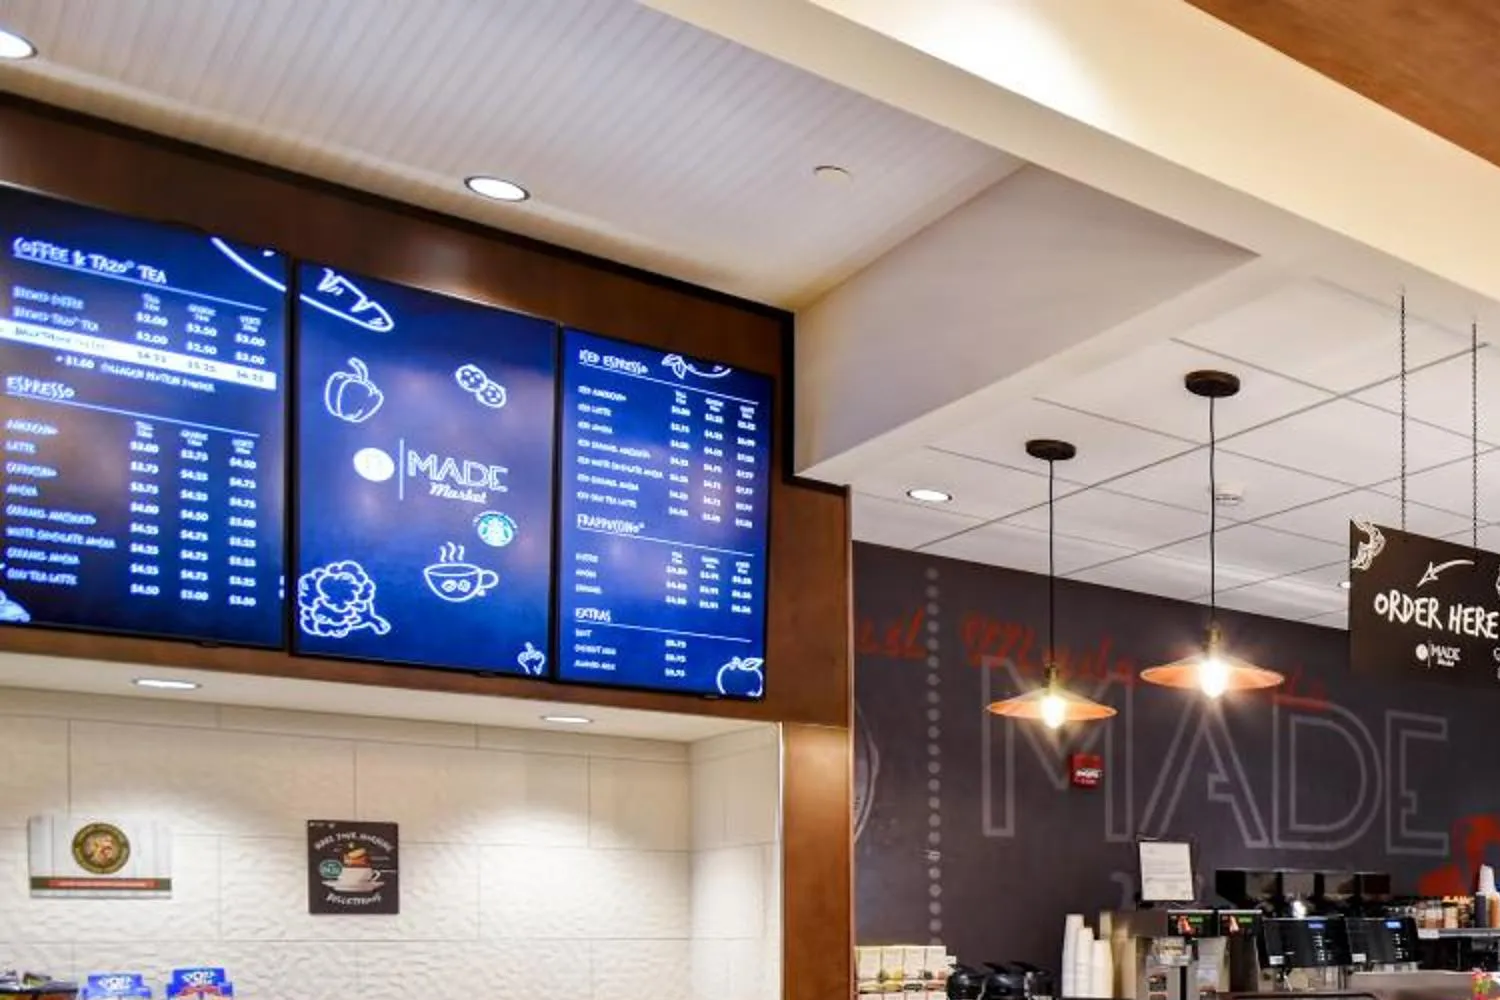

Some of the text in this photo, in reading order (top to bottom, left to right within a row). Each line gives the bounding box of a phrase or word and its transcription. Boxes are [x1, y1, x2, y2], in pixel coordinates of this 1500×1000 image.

[138, 264, 167, 285] TEA
[407, 449, 509, 493] MADE
[429, 482, 487, 505] Market
[1374, 589, 1500, 640] ORDER HERE
[982, 655, 1450, 857] MADE
